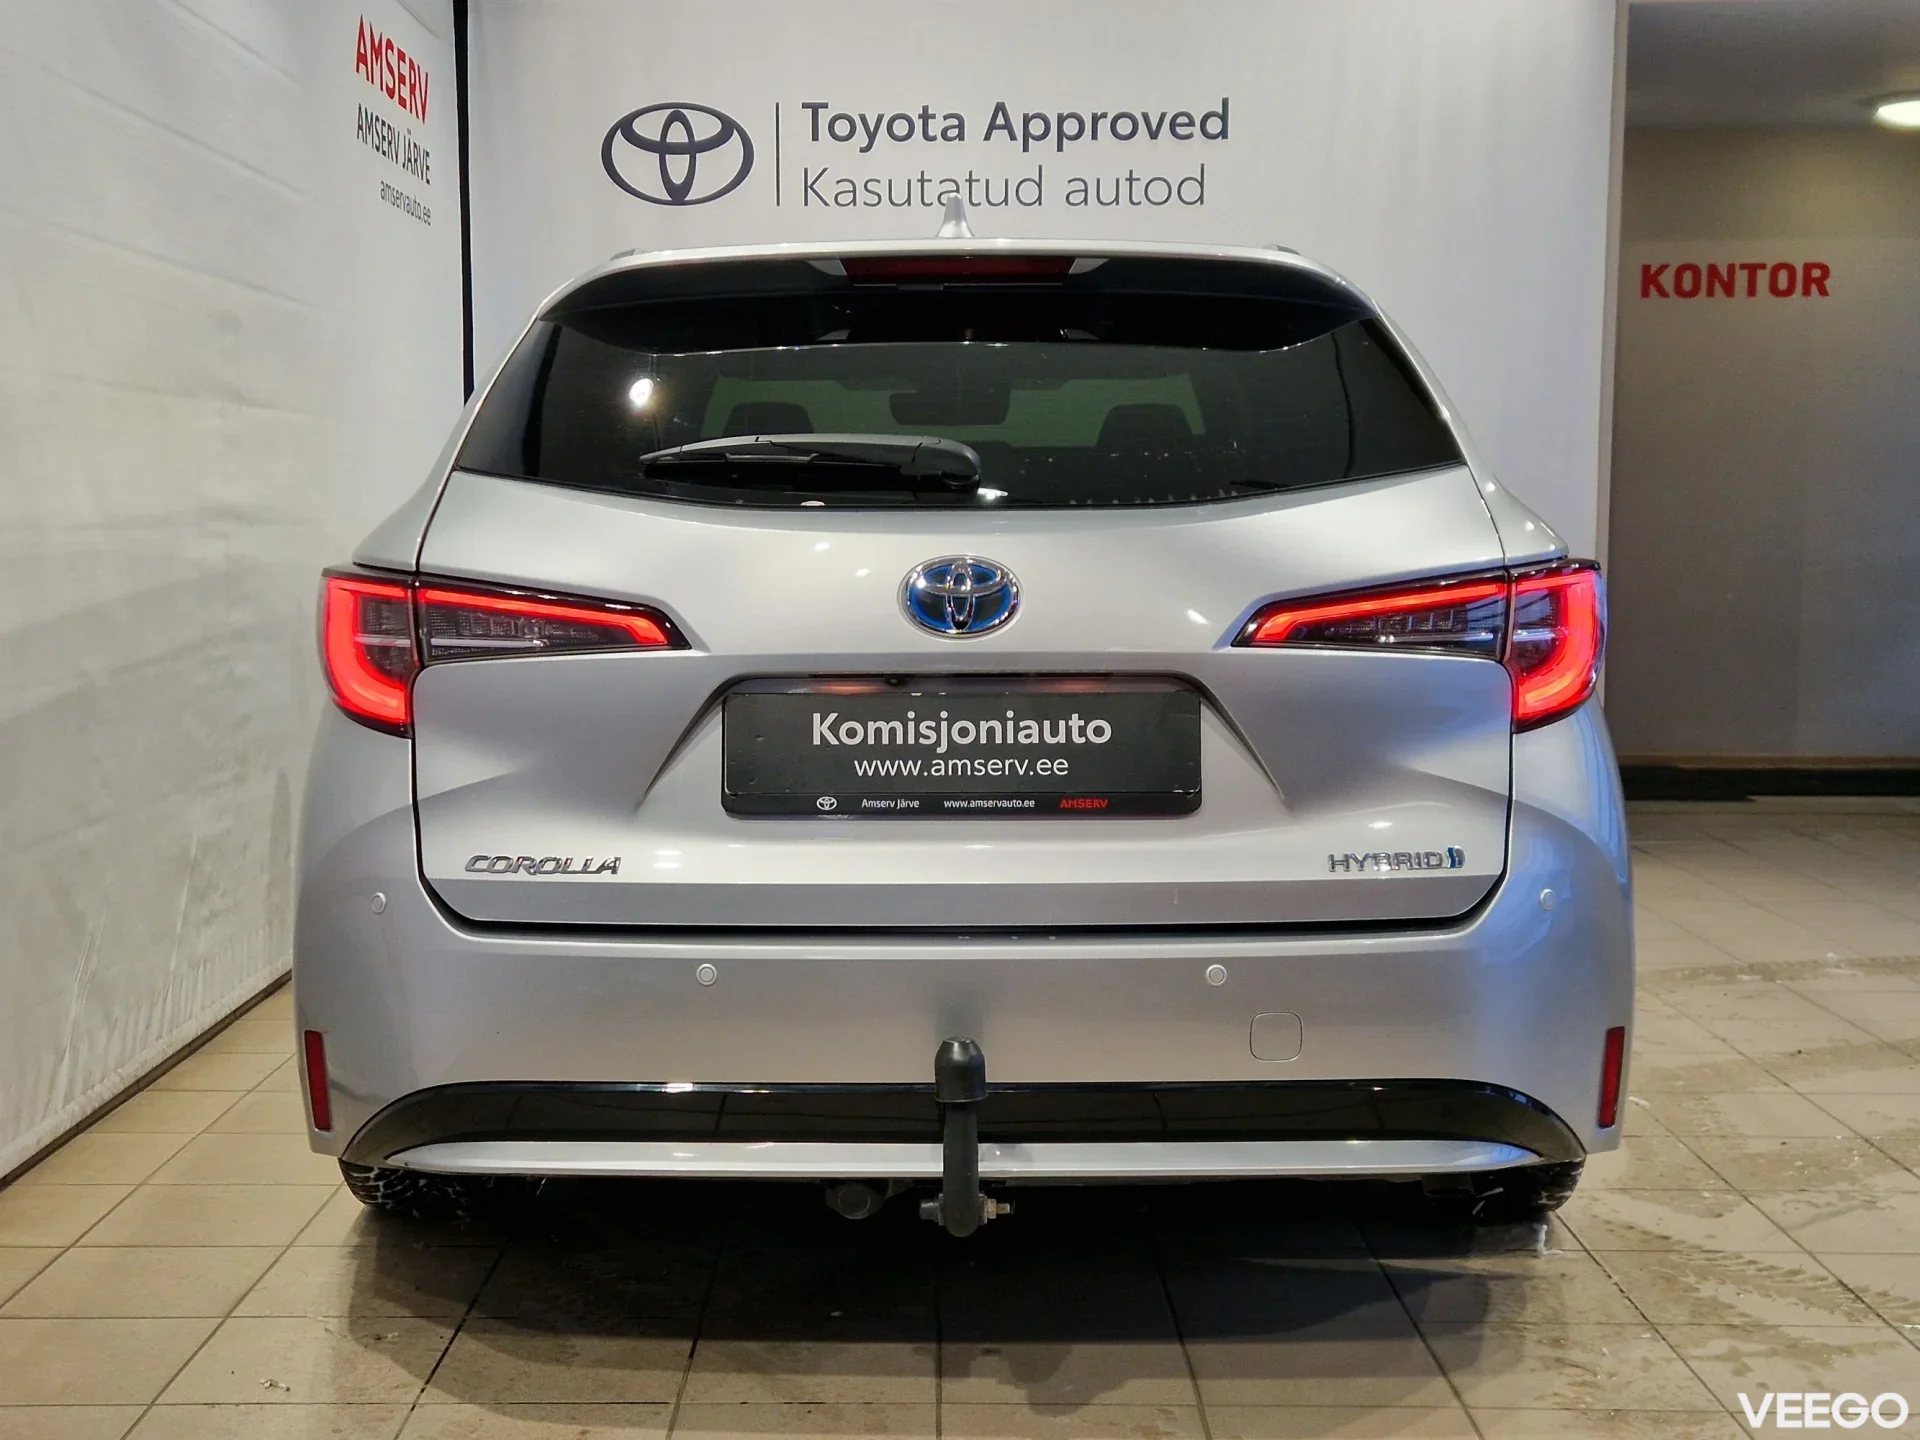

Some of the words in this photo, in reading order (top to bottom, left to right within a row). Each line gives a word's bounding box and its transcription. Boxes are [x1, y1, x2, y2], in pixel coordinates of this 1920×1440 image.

[356, 14, 429, 124] AMSERV
[801, 102, 966, 153] Toyota
[983, 97, 1230, 152] Approved
[357, 103, 400, 164] AMSERV
[402, 128, 431, 185] JÄRVE
[380, 180, 431, 226] amservauto.ee
[803, 164, 1044, 207] Kasutatud
[1065, 164, 1206, 206] autod
[1640, 262, 1831, 298] KONTOR
[812, 710, 1112, 753] Komisjoniauto
[854, 756, 1069, 776] www.amserv.ee
[861, 798, 895, 808] Amserv
[896, 798, 920, 809] Järve
[944, 798, 1036, 808] www.amservauto.ee
[1059, 798, 1109, 809] AMSERV
[465, 854, 621, 875] COROLLA
[1328, 852, 1443, 872] HYBRID
